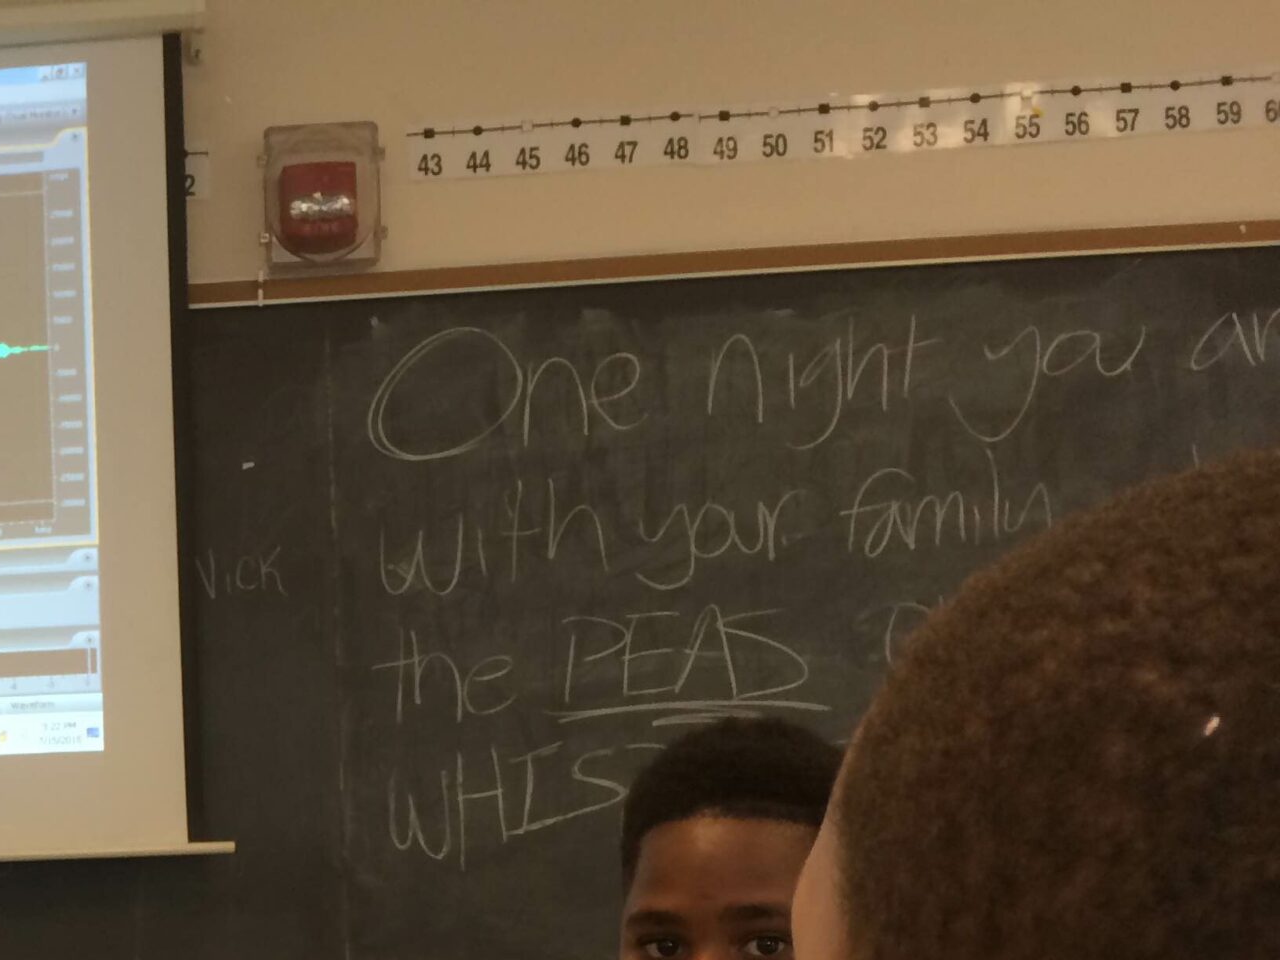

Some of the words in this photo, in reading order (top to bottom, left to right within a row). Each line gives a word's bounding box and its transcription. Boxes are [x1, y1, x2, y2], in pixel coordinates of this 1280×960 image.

[185, 175, 195, 196] 2
[418, 154, 442, 176] 43
[466, 150, 491, 173] 44
[515, 147, 540, 170] 45
[564, 143, 589, 166] 46
[614, 141, 637, 163] 47
[663, 137, 688, 160] 48
[713, 136, 738, 160] 49
[763, 133, 787, 157] 50
[813, 130, 834, 153] 51
[862, 127, 887, 151] 52
[913, 123, 938, 147] 53
[964, 119, 989, 143] 54
[1015, 115, 1040, 139] 55
[1065, 112, 1090, 136] 56
[1116, 109, 1139, 132] 57
[1165, 105, 1190, 129] 58
[1217, 101, 1241, 125] 59
[1265, 99, 1280, 123] 6
[368, 326, 649, 460] One
[948, 325, 1147, 442] you
[380, 478, 610, 596] with
[634, 489, 806, 591] your
[372, 626, 518, 723] the
